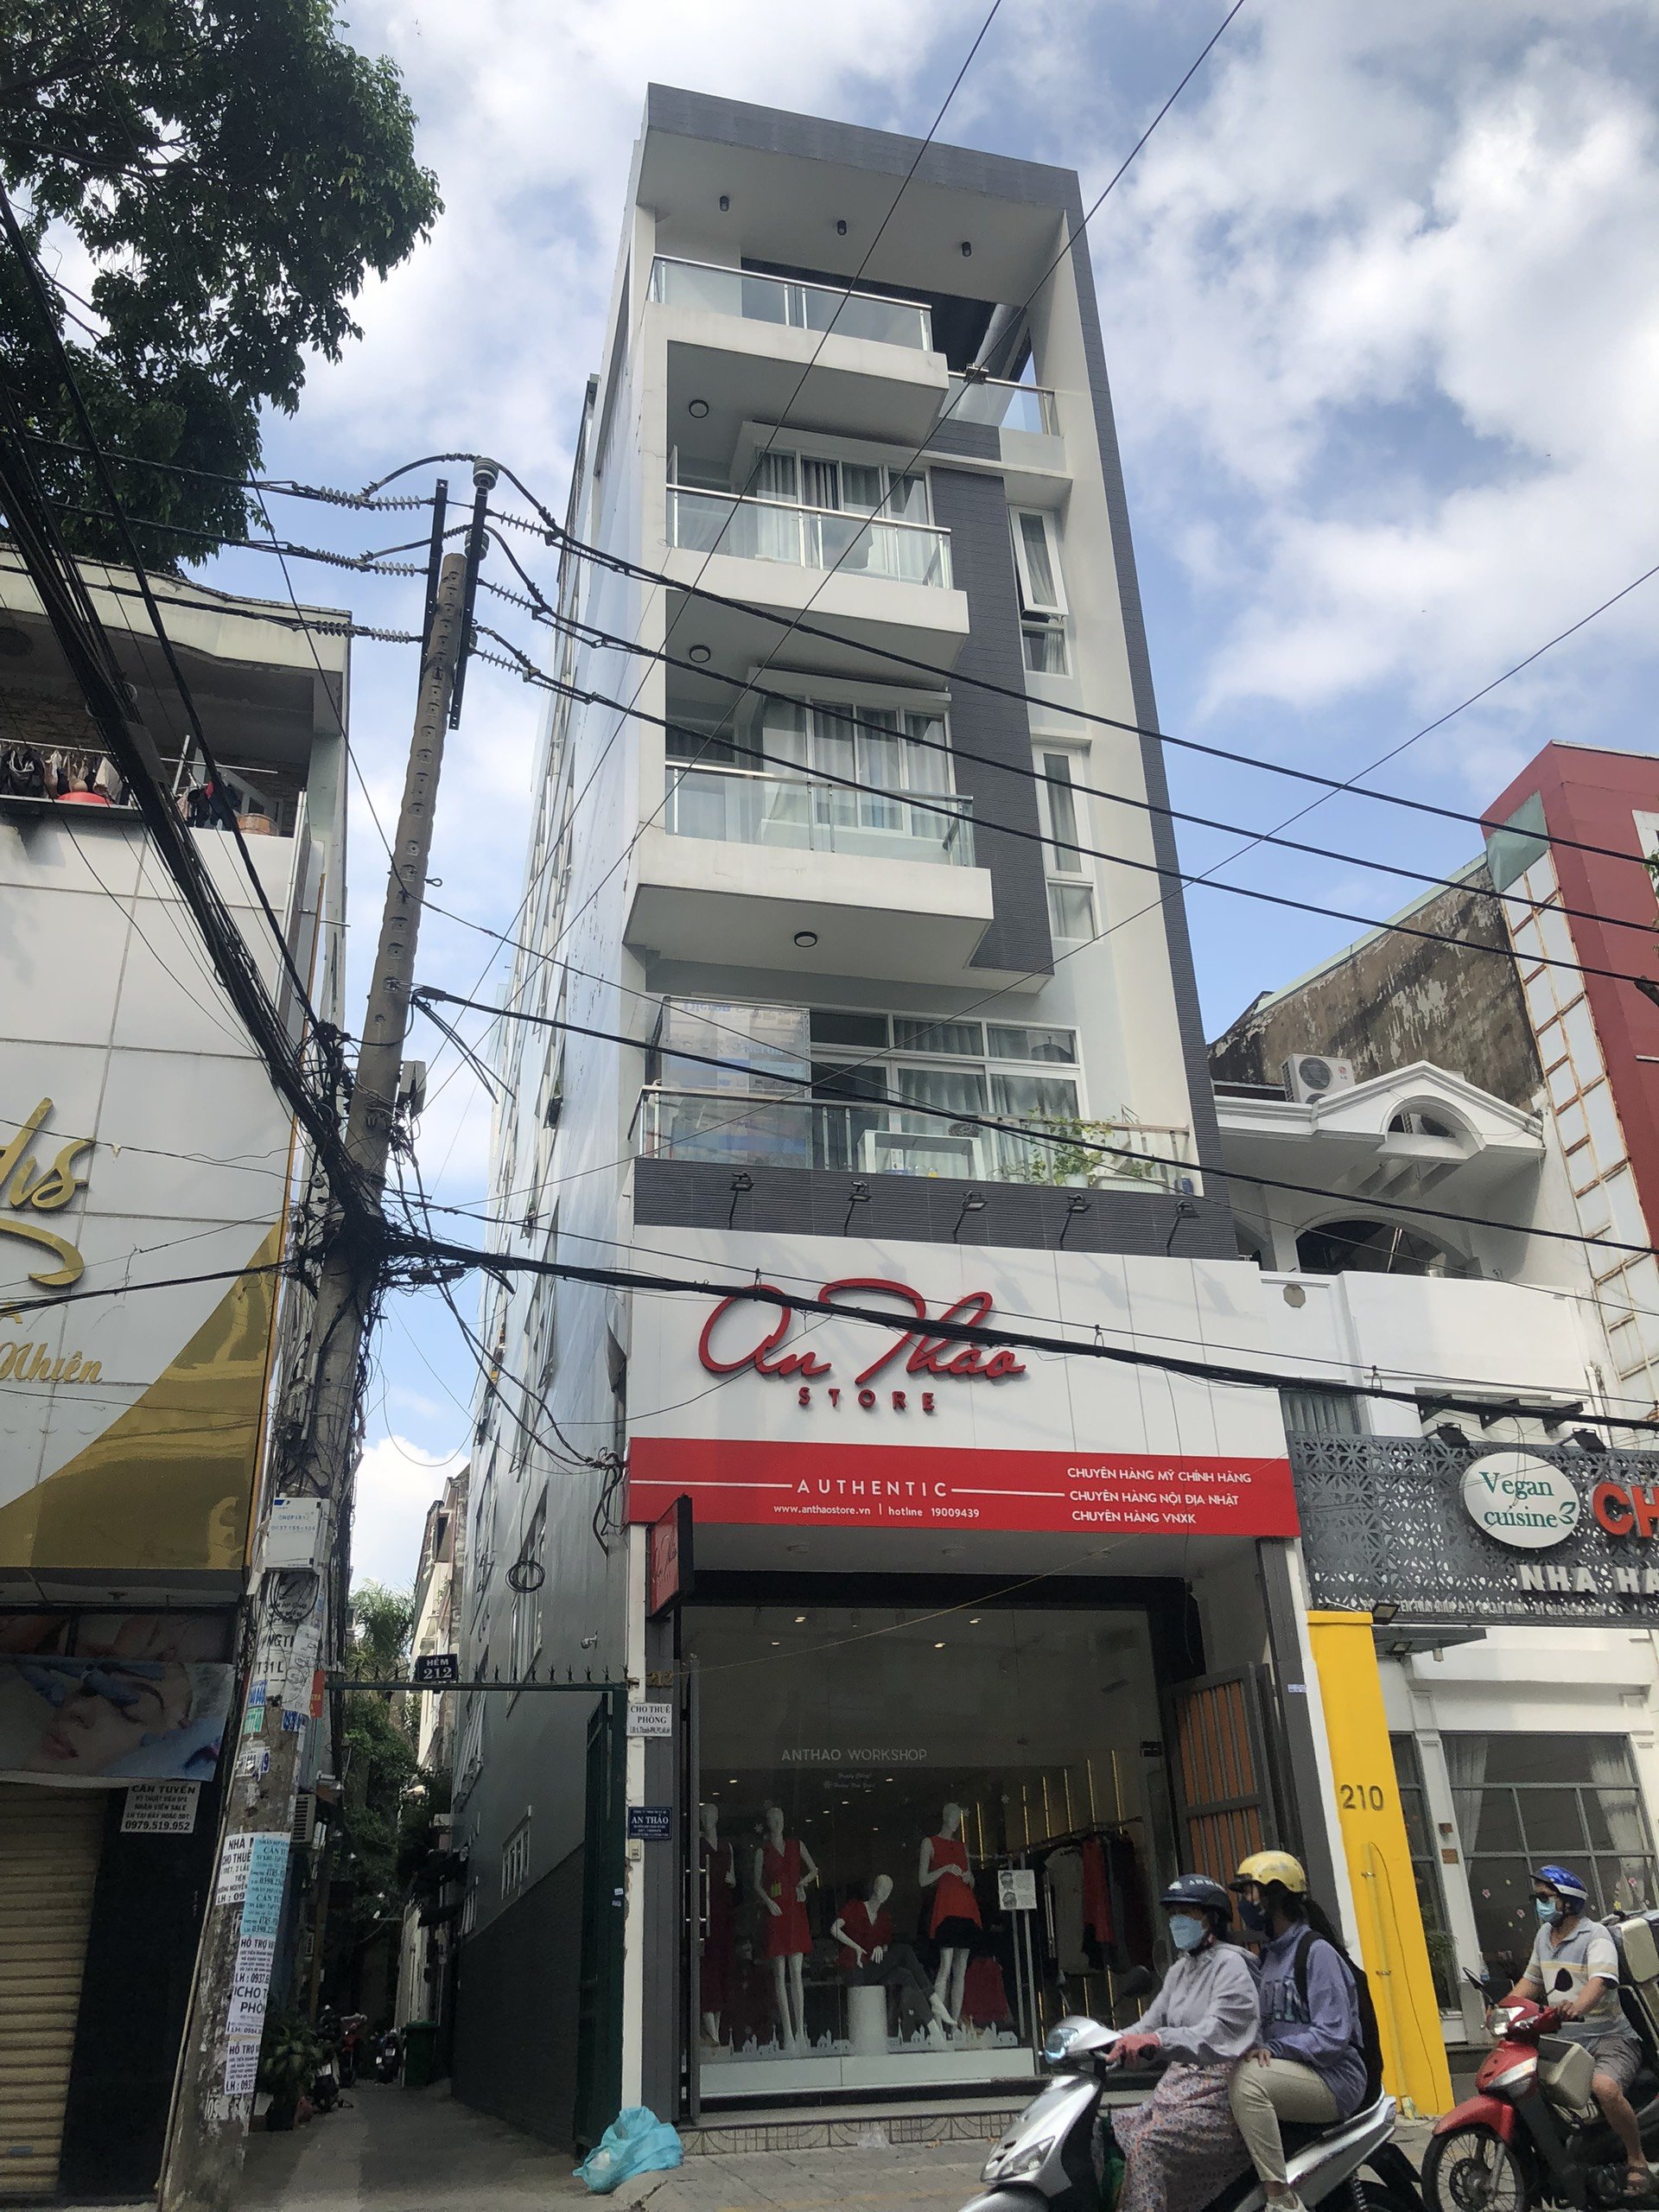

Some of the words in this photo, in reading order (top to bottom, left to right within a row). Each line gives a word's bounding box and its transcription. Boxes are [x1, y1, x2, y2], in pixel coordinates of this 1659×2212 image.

[798, 1386, 936, 1412] STORE
[1067, 1466, 1116, 1479] CHUYÊN
[1120, 1467, 1154, 1480] HÀNG
[1158, 1470, 1174, 1481] MỸ
[1178, 1470, 1214, 1483] CHÍNH
[797, 1478, 947, 1497] AUTHENTIC
[1478, 1471, 1554, 1500] Vegan
[1070, 1490, 1119, 1503] CHUYÊN
[1122, 1490, 1157, 1503] HÀNG
[1160, 1492, 1181, 1506] NỘI
[1185, 1495, 1205, 1507] ĐỊA
[1209, 1494, 1239, 1507] NHẬT
[773, 1504, 871, 1516] www.anthaostore.vn
[888, 1506, 923, 1516] hotline
[931, 1507, 980, 1518] 19009439
[1072, 1510, 1121, 1522] CHUYÊN
[1124, 1510, 1160, 1523] HÀNG
[1162, 1514, 1196, 1524] VNXK
[1484, 1510, 1558, 1528] cuisine
[423, 1667, 453, 1680] 212
[649, 1705, 671, 1713] THUÊ
[637, 1715, 667, 1724] PHÒNG
[781, 1749, 842, 1762] ANTHAO
[847, 1749, 927, 1762] WORKSHOP
[1340, 1784, 1384, 1811] 210
[632, 1815, 645, 1824] AN
[645, 1814, 669, 1824] THẢO
[232, 1849, 251, 1864] THUÊ
[218, 1895, 226, 1904] LH
[235, 1973, 245, 1983] LH
[226, 2081, 235, 2091] LH
